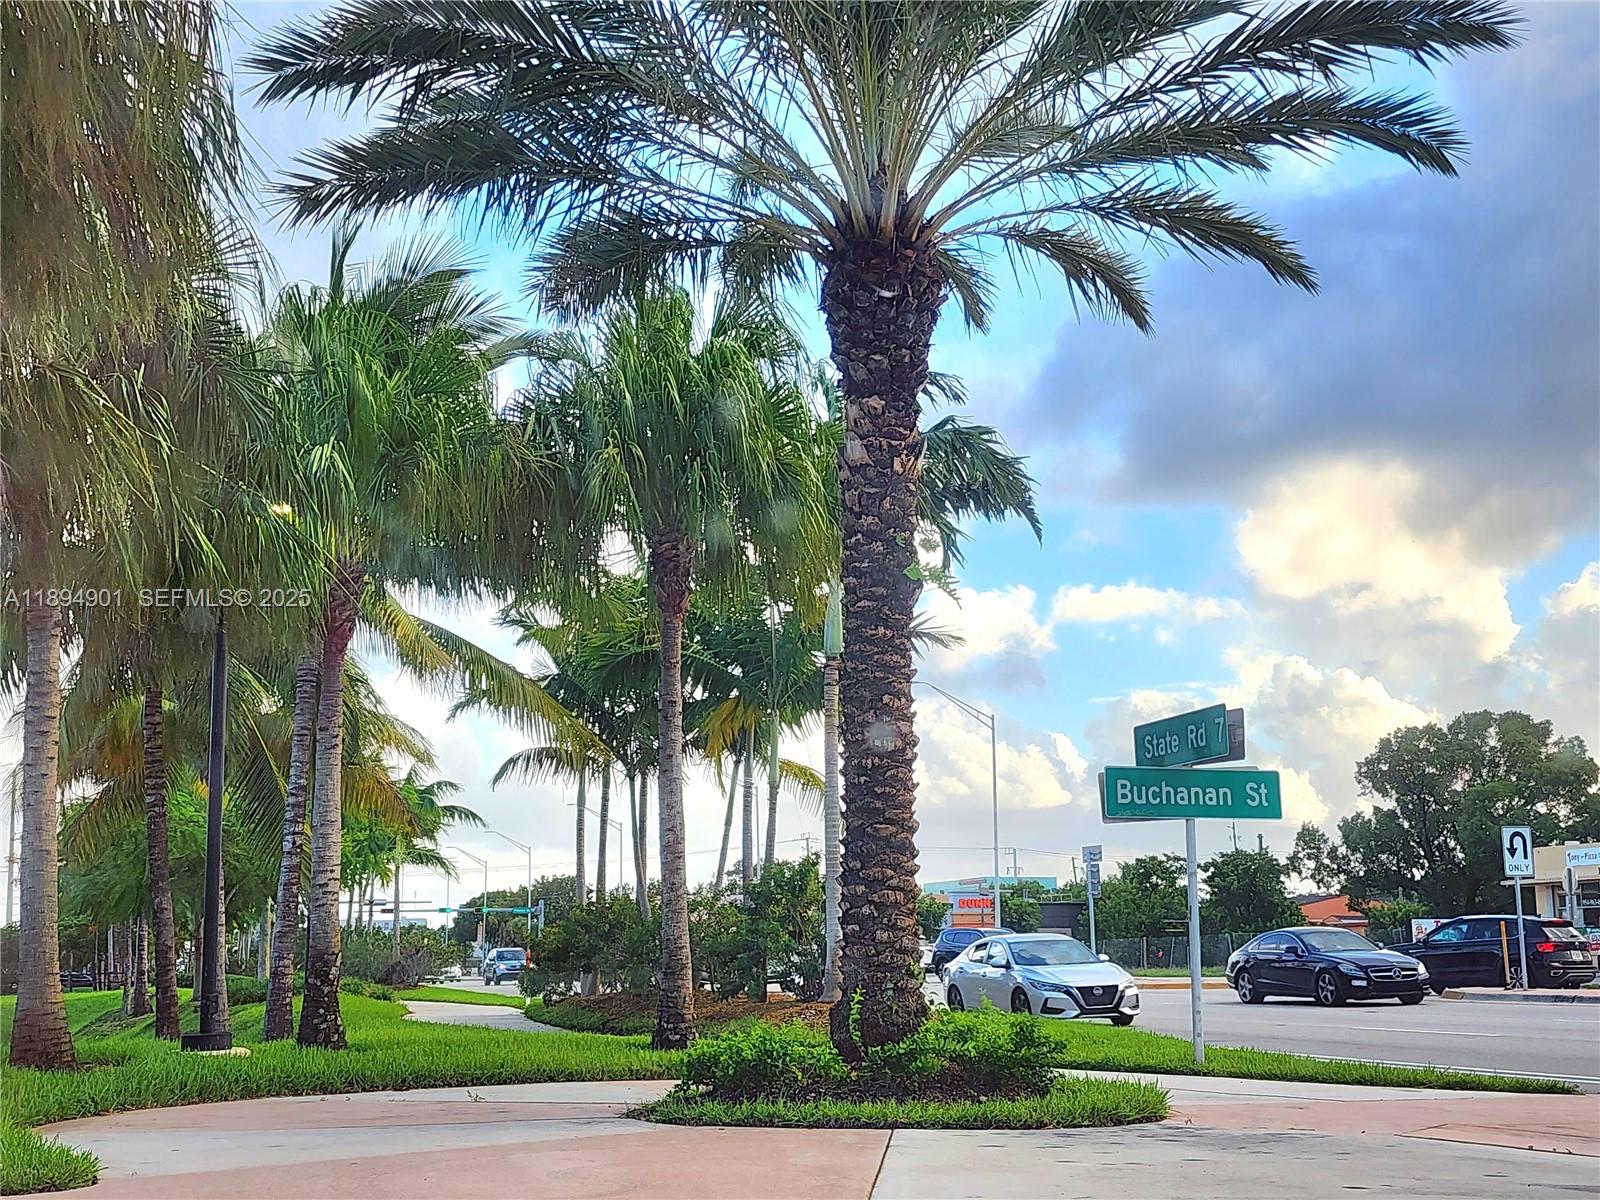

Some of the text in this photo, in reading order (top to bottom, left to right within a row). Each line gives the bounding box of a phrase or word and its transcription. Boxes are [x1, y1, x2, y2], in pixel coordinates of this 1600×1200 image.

[1144, 717, 1224, 759] State Rd 7
[1116, 779, 1269, 807] Buchanan St
[1508, 863, 1530, 873] ONLY
